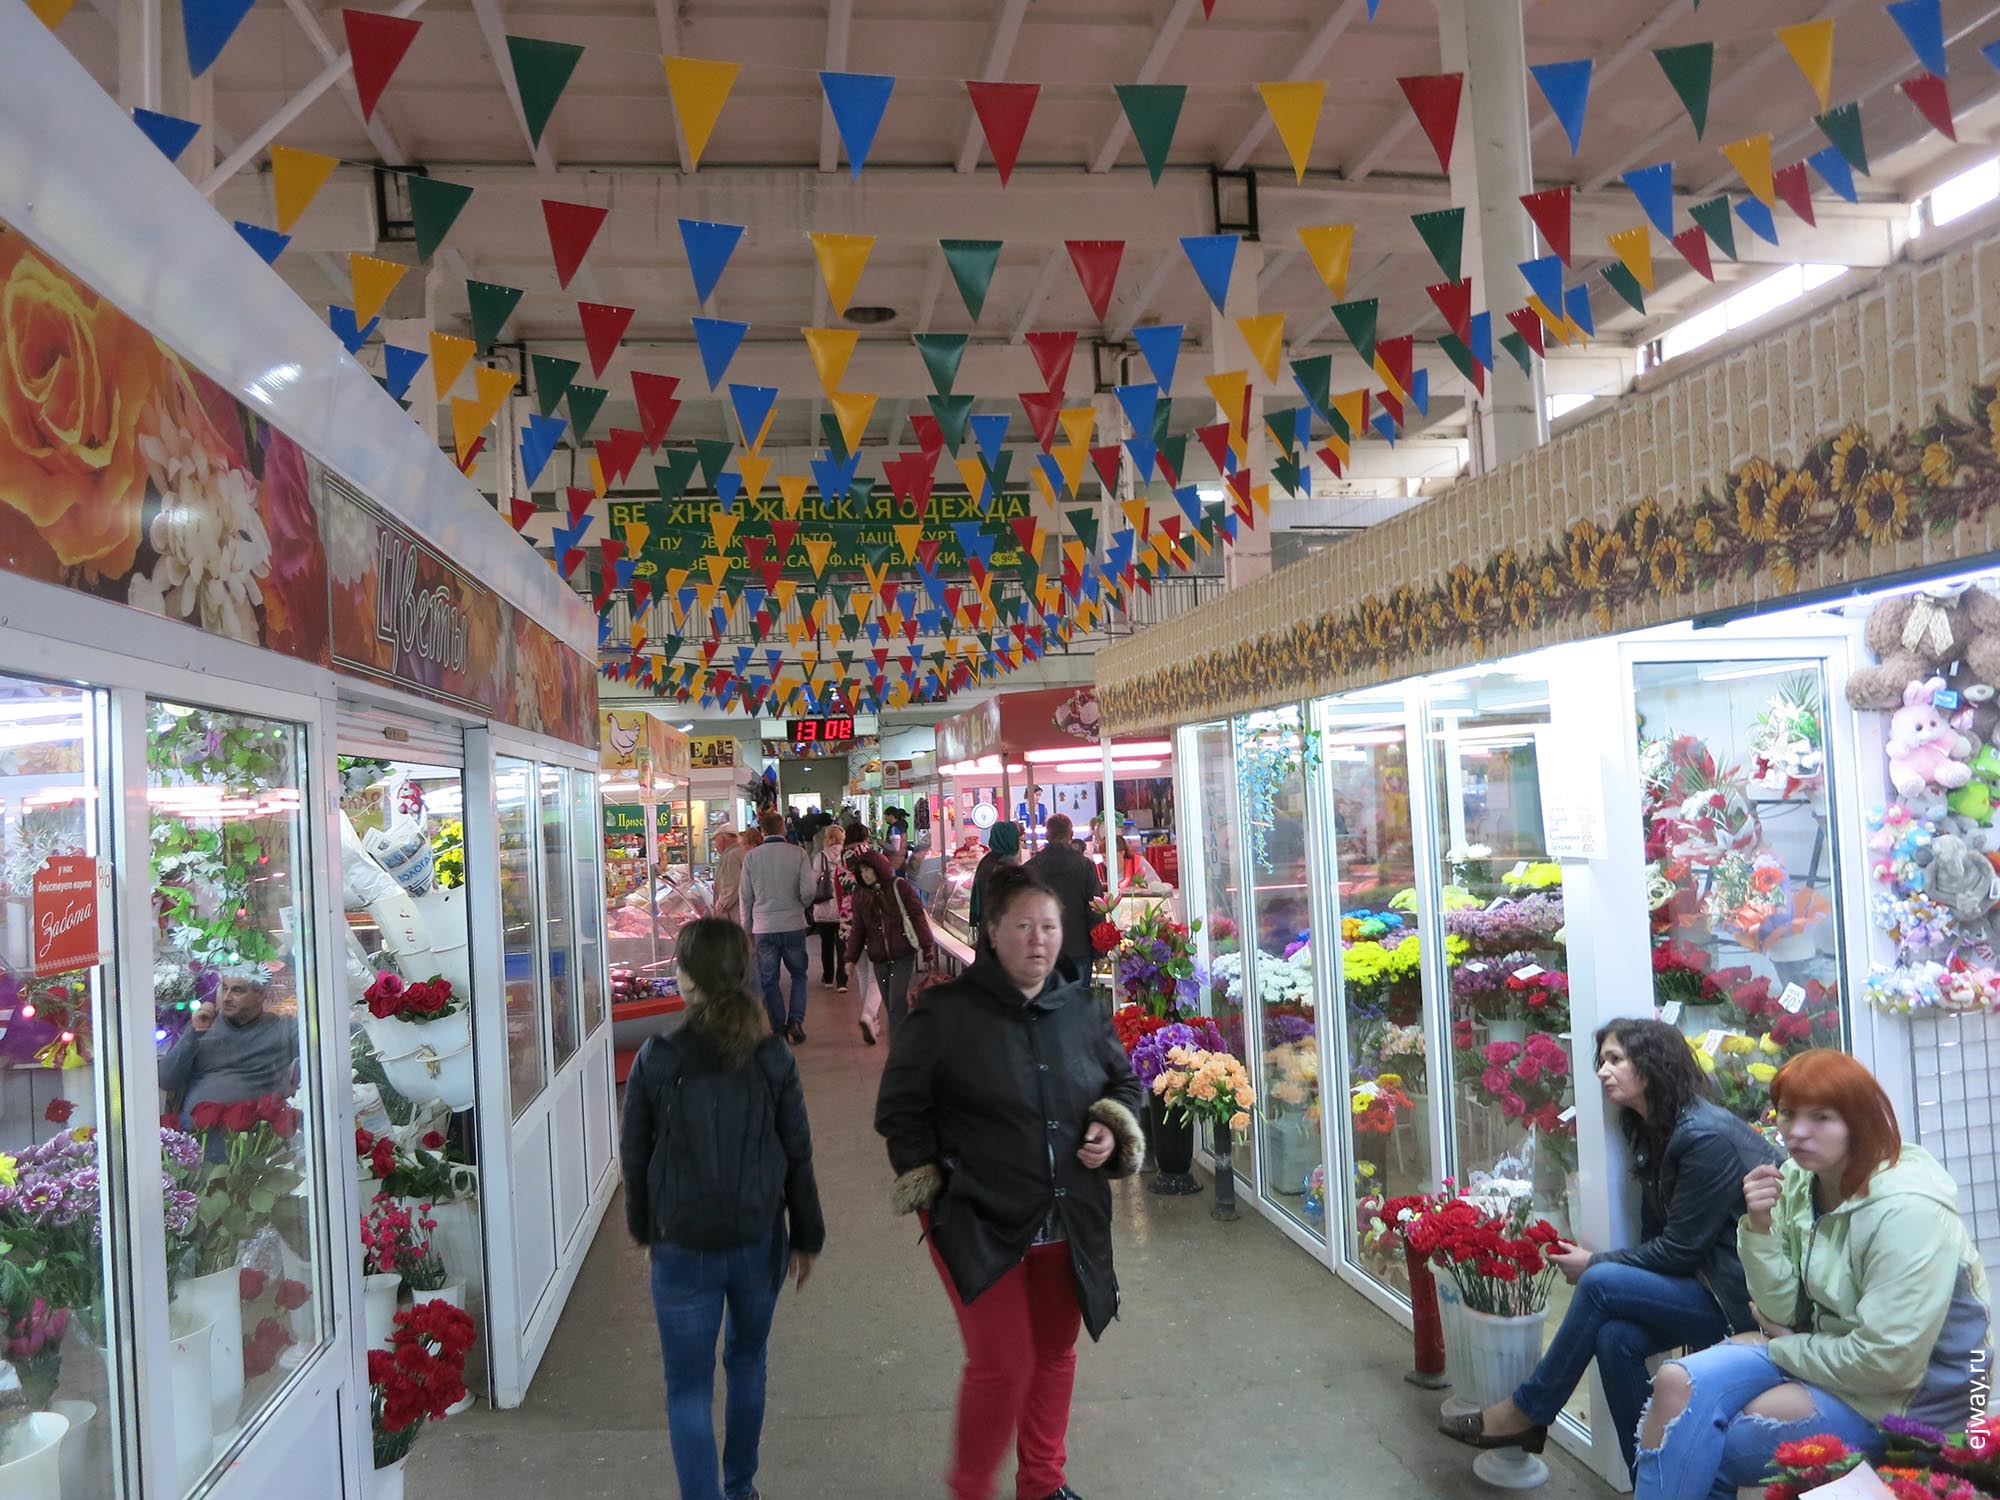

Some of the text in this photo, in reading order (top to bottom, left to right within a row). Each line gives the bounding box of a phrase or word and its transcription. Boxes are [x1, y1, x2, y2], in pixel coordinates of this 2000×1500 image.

[613, 502, 745, 526] ВЕХНЯЯ
[905, 497, 1024, 524] ОДЕЖДА
[377, 531, 467, 675] Цветы
[797, 721, 817, 741] 13
[39, 900, 93, 958] Забота
